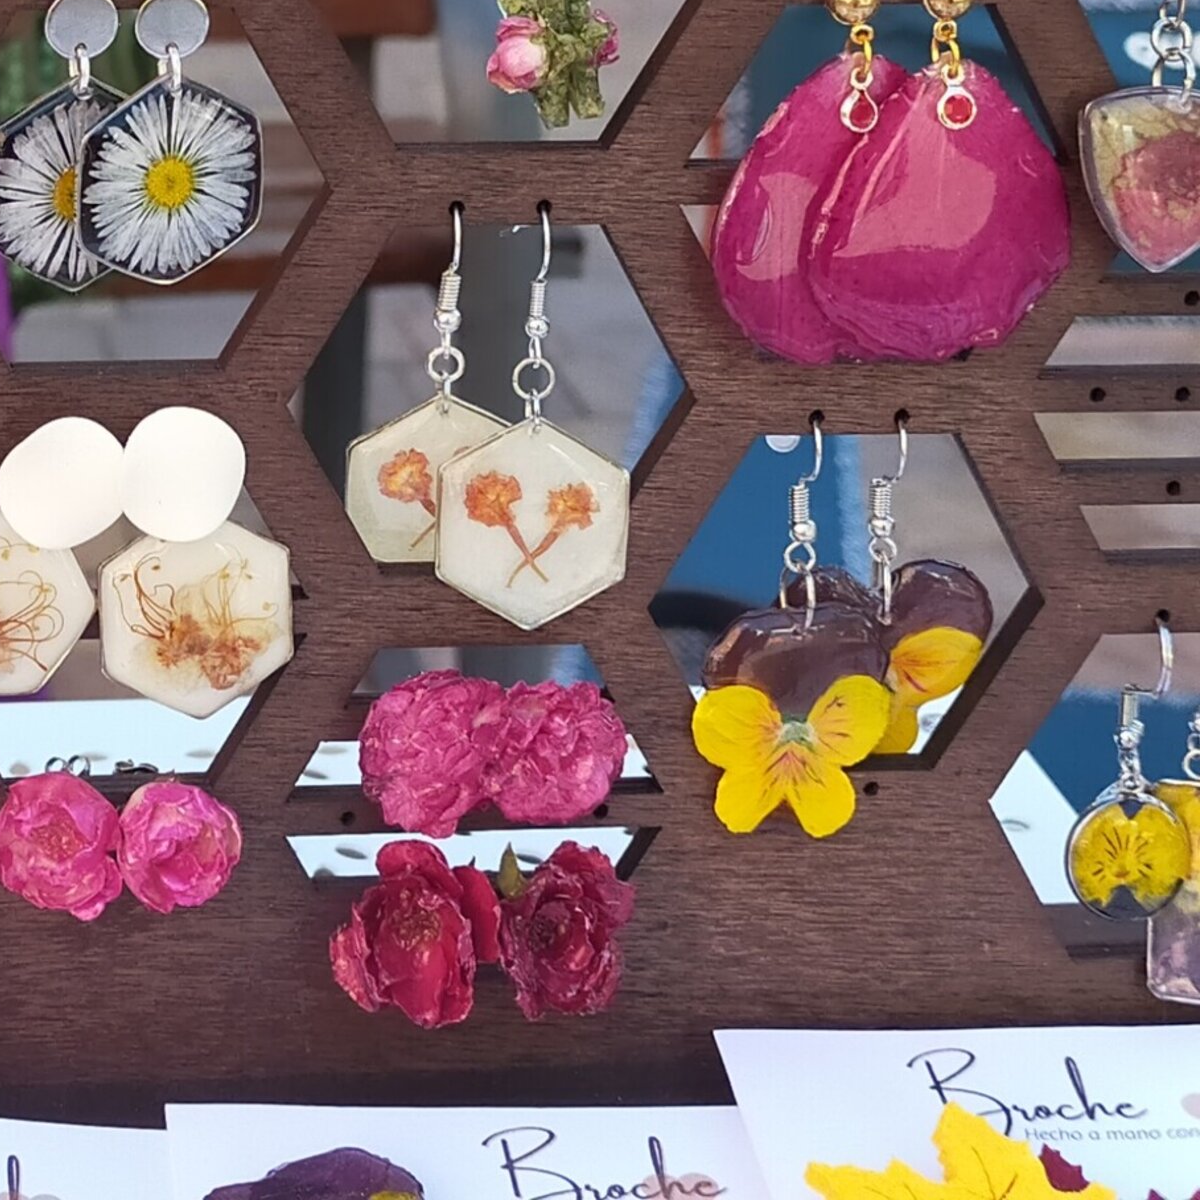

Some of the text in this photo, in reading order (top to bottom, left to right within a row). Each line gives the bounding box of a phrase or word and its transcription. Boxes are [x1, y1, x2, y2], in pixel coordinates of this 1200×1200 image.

[906, 1047, 1148, 1137] Broche
[481, 1126, 728, 1200] Broche
[1025, 1128, 1083, 1141] Hecho
[1088, 1130, 1100, 1140] a
[1106, 1129, 1162, 1140] mano
